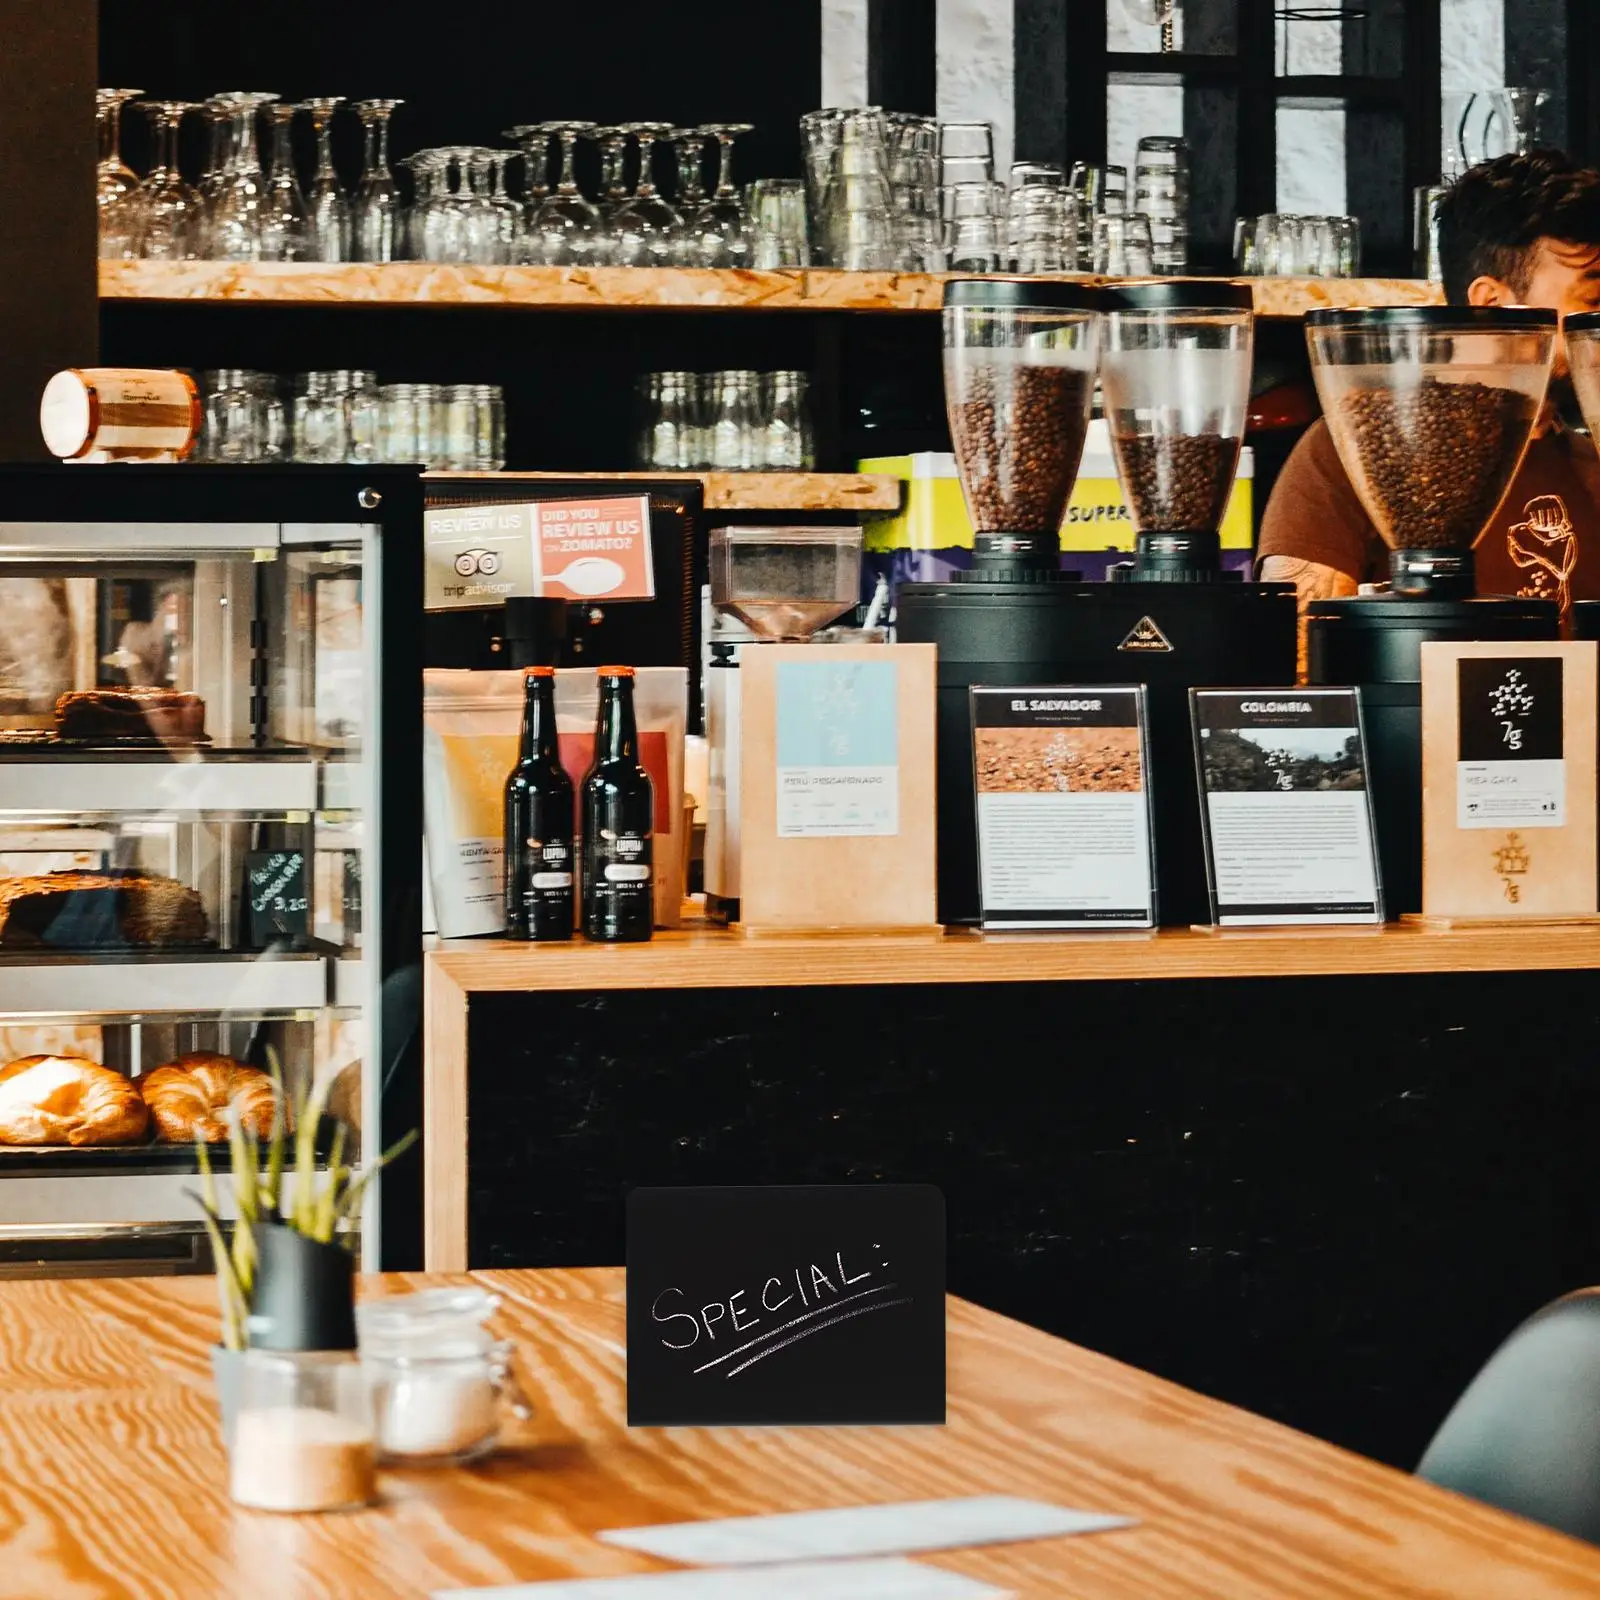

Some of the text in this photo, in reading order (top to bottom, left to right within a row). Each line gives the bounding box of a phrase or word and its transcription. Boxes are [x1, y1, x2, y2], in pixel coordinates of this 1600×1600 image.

[542, 510, 568, 522] DID
[569, 508, 600, 520] YOU
[1069, 505, 1131, 523] SUPER
[430, 514, 522, 534] REVIEW US
[542, 519, 641, 539] REVIEW US
[559, 537, 633, 553] ZOMATO?
[1011, 700, 1102, 711] EL SALVADOR
[1240, 701, 1312, 713] COLOMBIA
[652, 1243, 889, 1349] SPECIAL:
